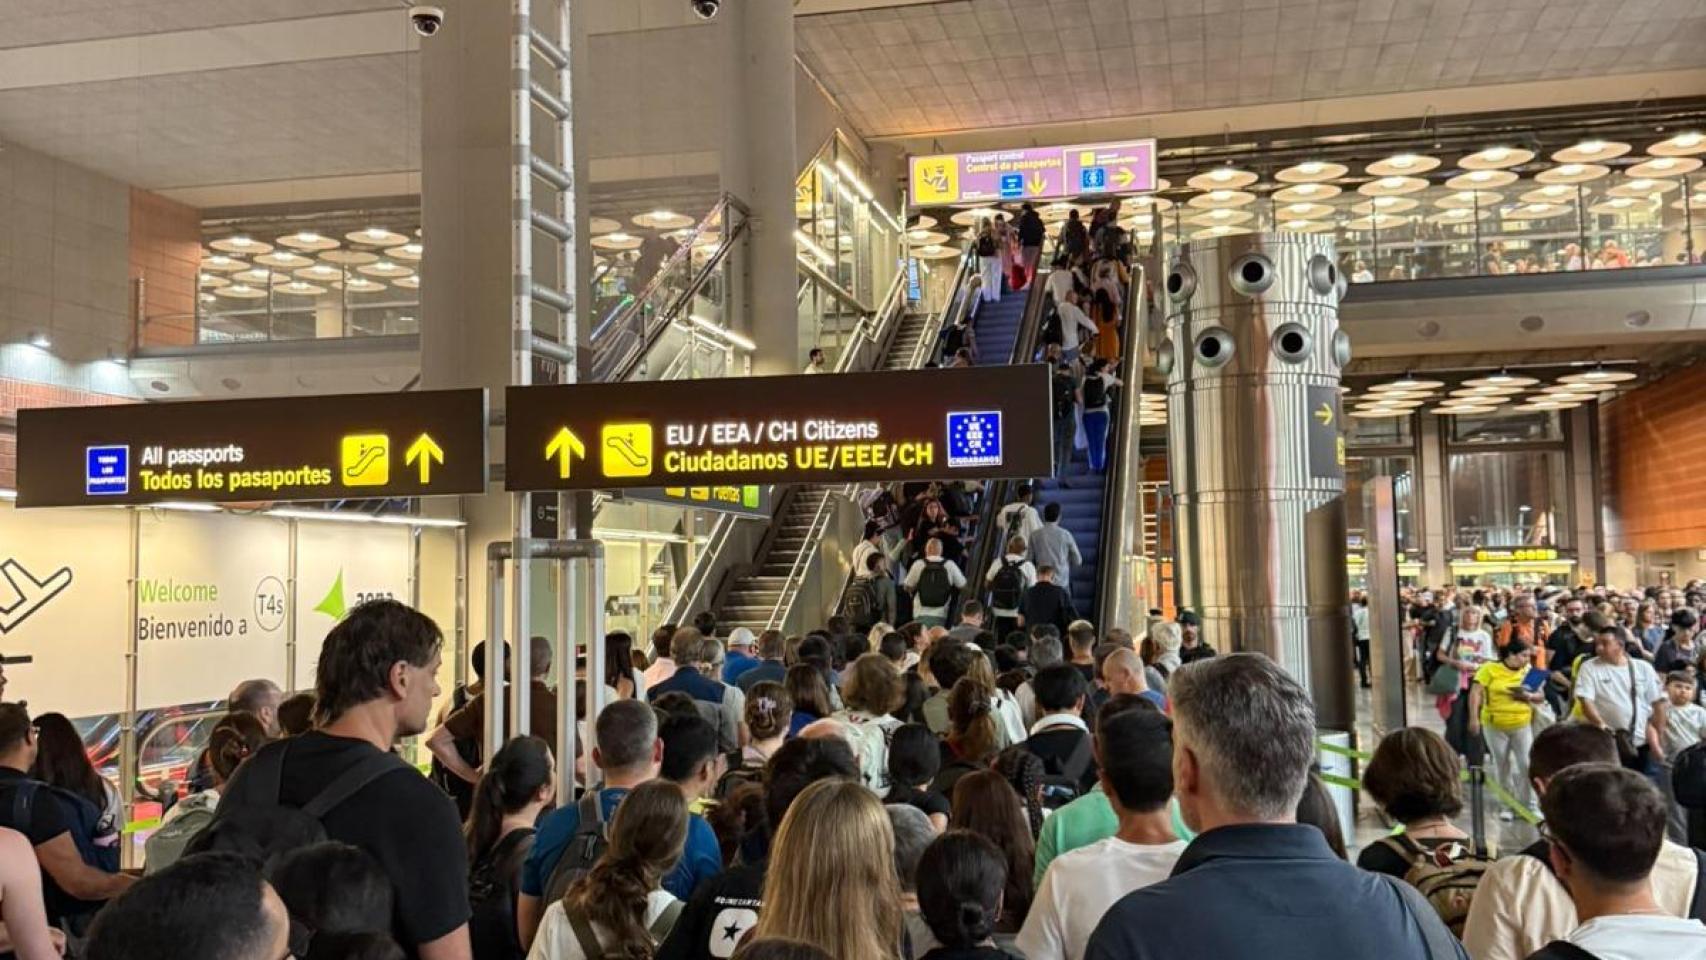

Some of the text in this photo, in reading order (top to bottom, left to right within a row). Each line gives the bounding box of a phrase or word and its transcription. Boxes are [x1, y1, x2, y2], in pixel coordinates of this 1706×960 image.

[666, 419, 879, 445] EU / EEA / CH Citizens
[142, 444, 244, 468] All passports
[664, 443, 933, 473] Ciudadanos UE/EEE/CH
[140, 465, 332, 492] Todos los pasaportes
[139, 579, 218, 603] Welcome
[258, 594, 284, 615] T4s
[138, 614, 248, 640] Bienvenido a
